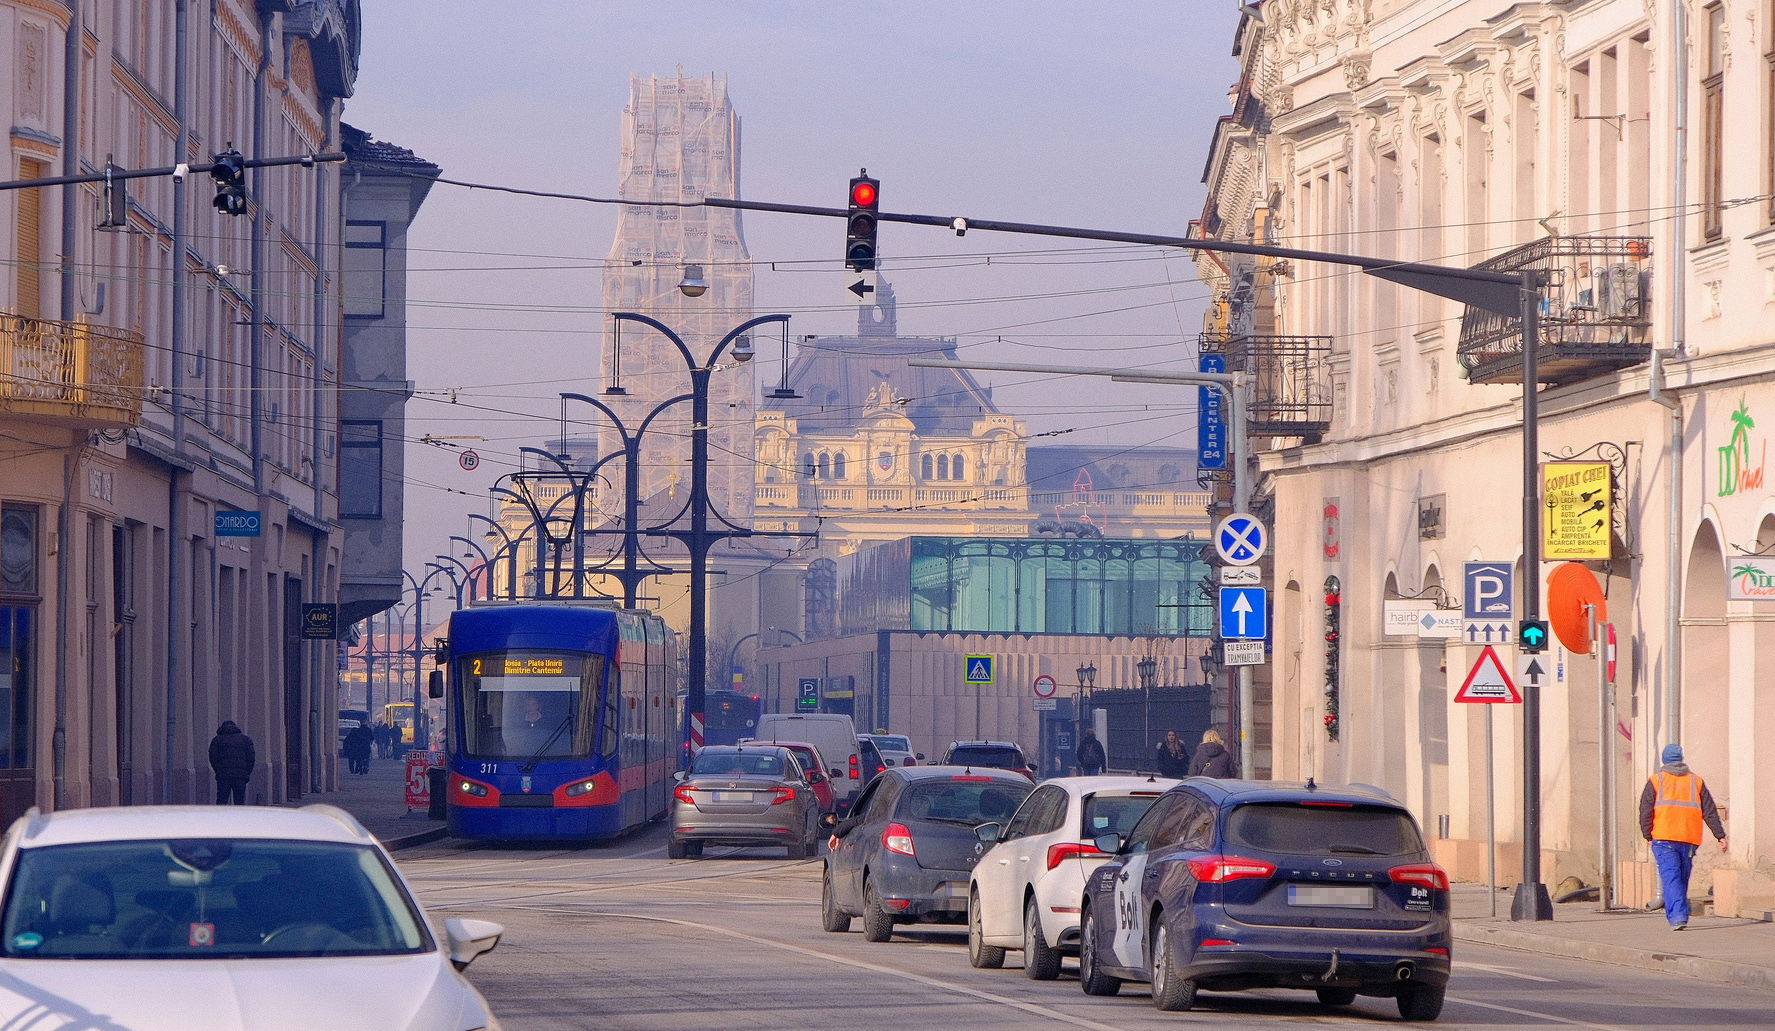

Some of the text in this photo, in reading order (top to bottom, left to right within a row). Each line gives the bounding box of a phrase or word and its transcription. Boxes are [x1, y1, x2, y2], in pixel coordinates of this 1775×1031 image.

[1203, 450, 1221, 459] 24
[464, 456, 475, 466] 15
[1546, 466, 1606, 492] COPIAT CHEI
[1474, 576, 1504, 613] P
[312, 613, 328, 621] AUR
[473, 659, 481, 675] 2
[504, 666, 563, 674] Dimitrie Cantemir
[480, 763, 497, 774] 311
[1411, 887, 1428, 898] Bolt
[1120, 891, 1139, 931] Bolt
